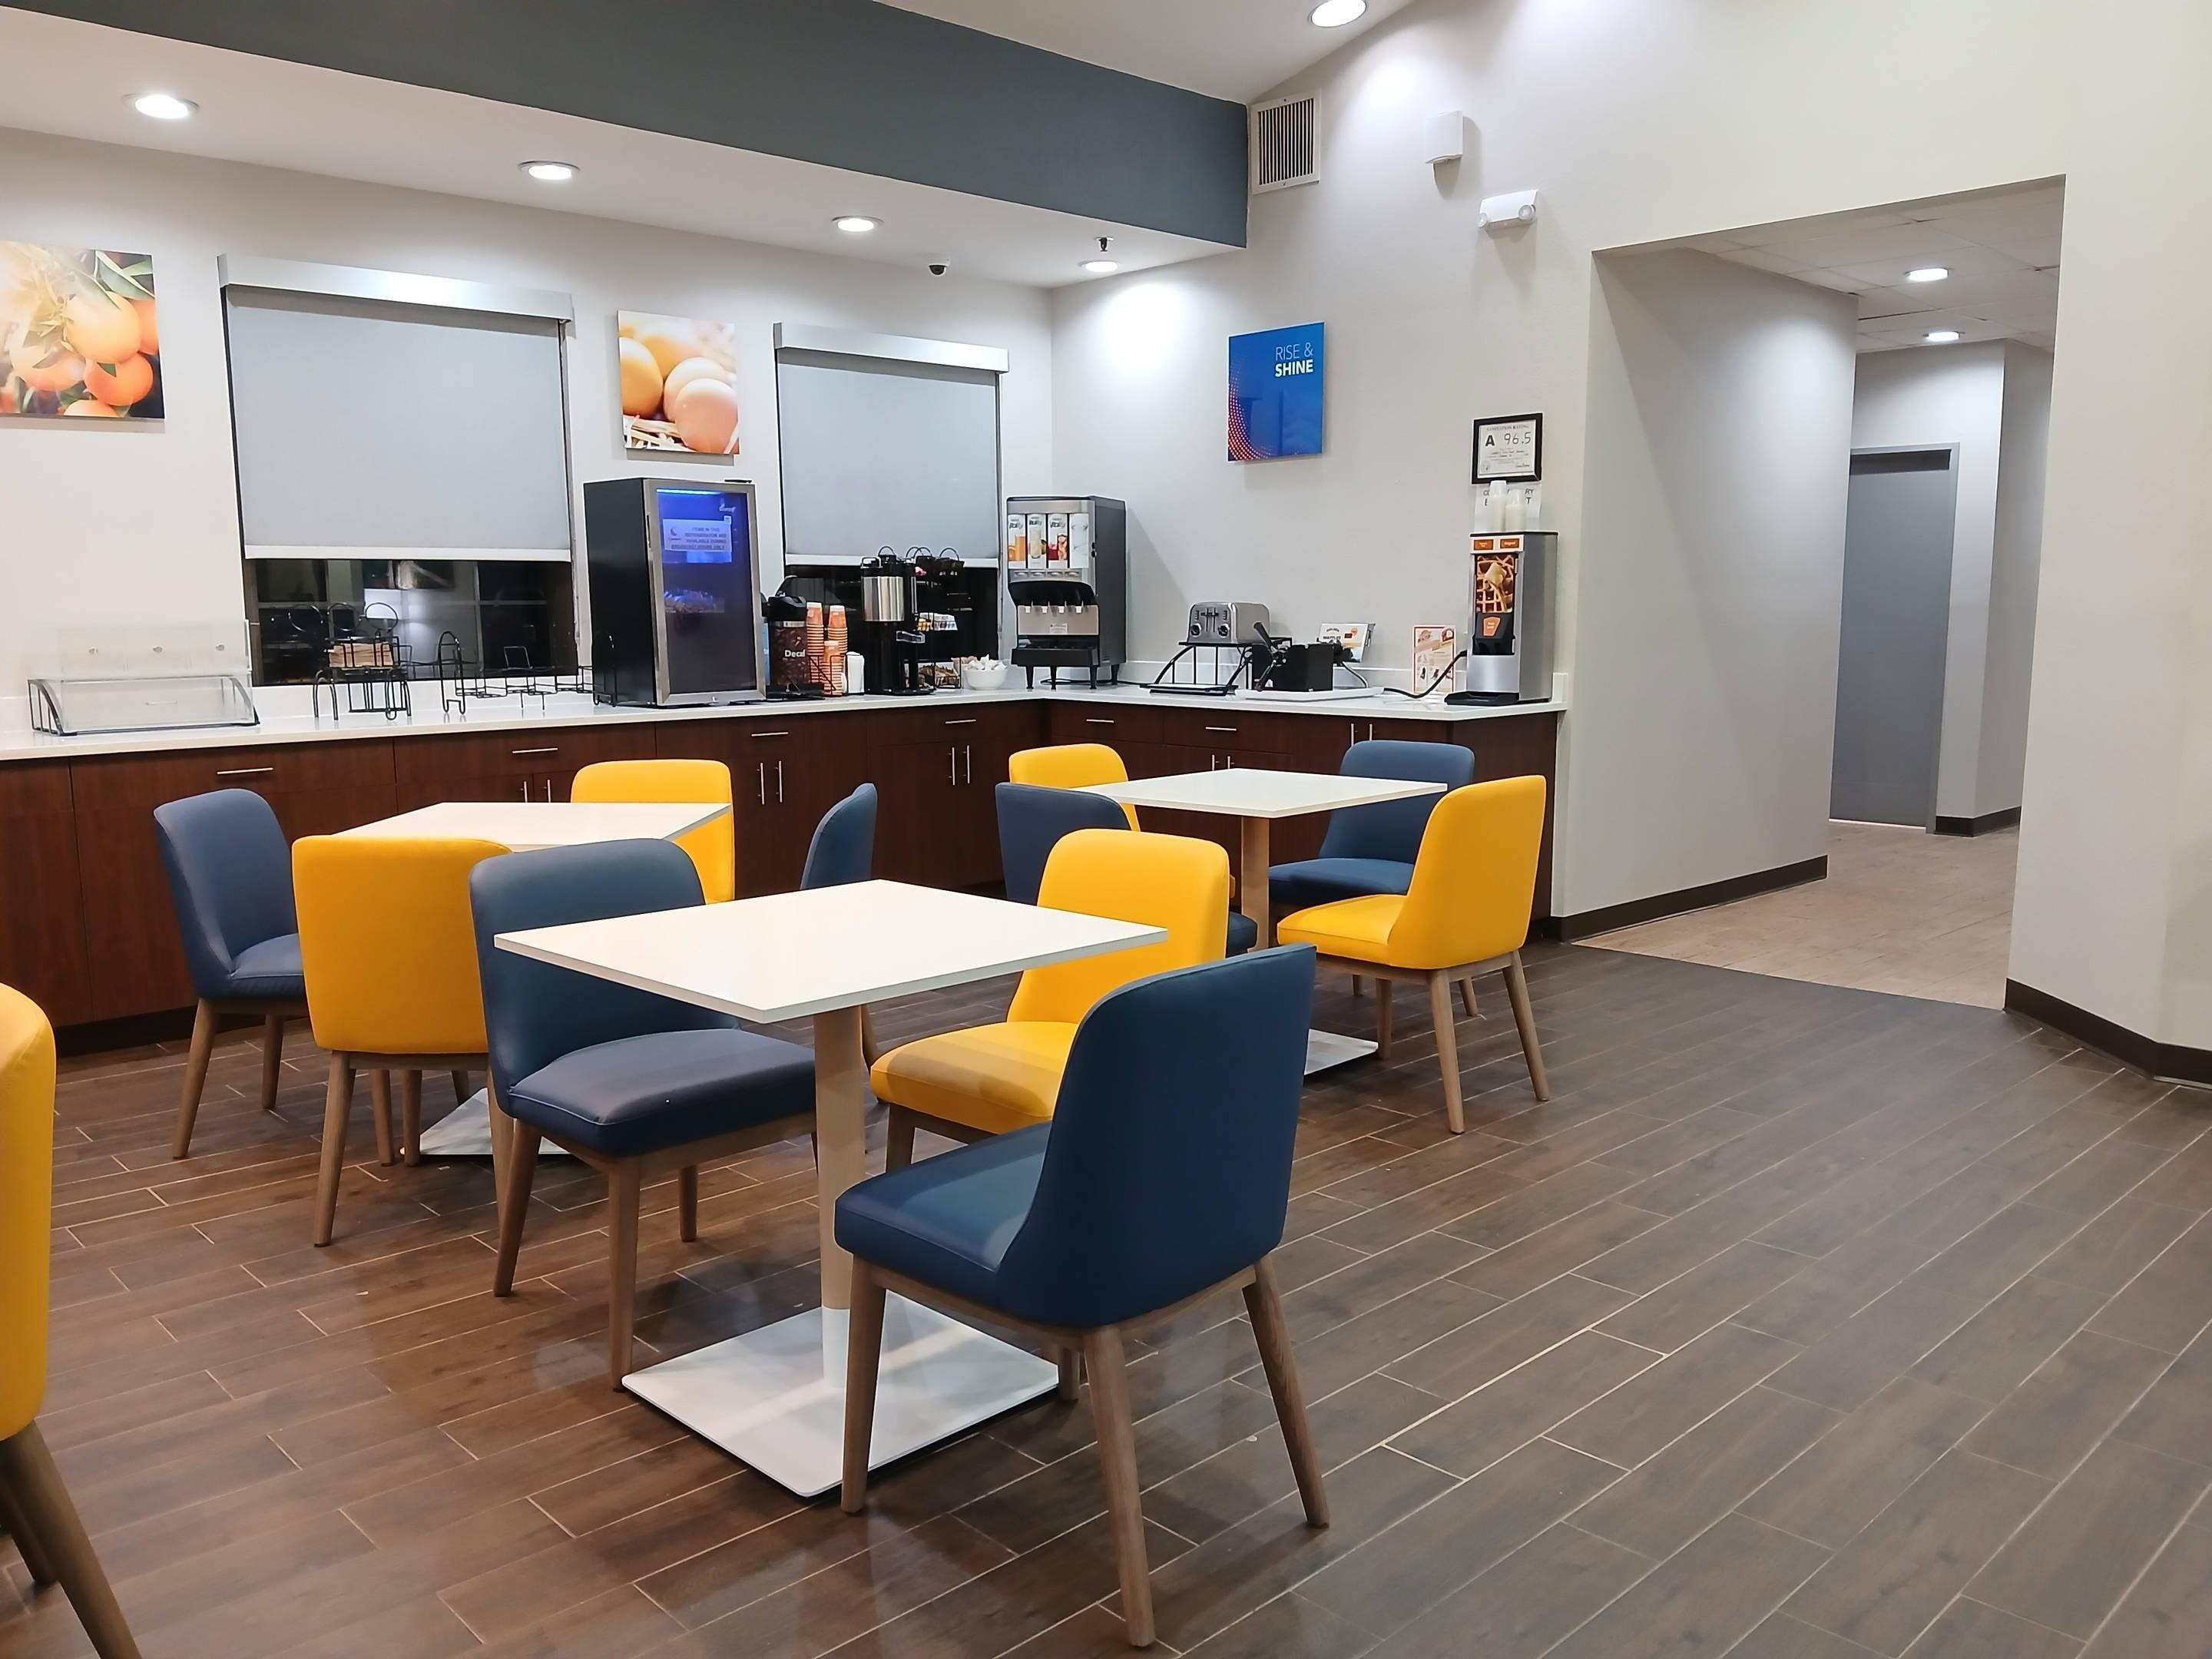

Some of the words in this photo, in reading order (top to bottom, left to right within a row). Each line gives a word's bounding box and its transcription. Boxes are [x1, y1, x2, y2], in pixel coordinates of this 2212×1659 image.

[1276, 343, 1300, 361] RISE
[1304, 342, 1313, 357] &
[1275, 359, 1313, 377] SHINE
[1485, 434, 1495, 446] A
[1504, 432, 1531, 445] 96.5
